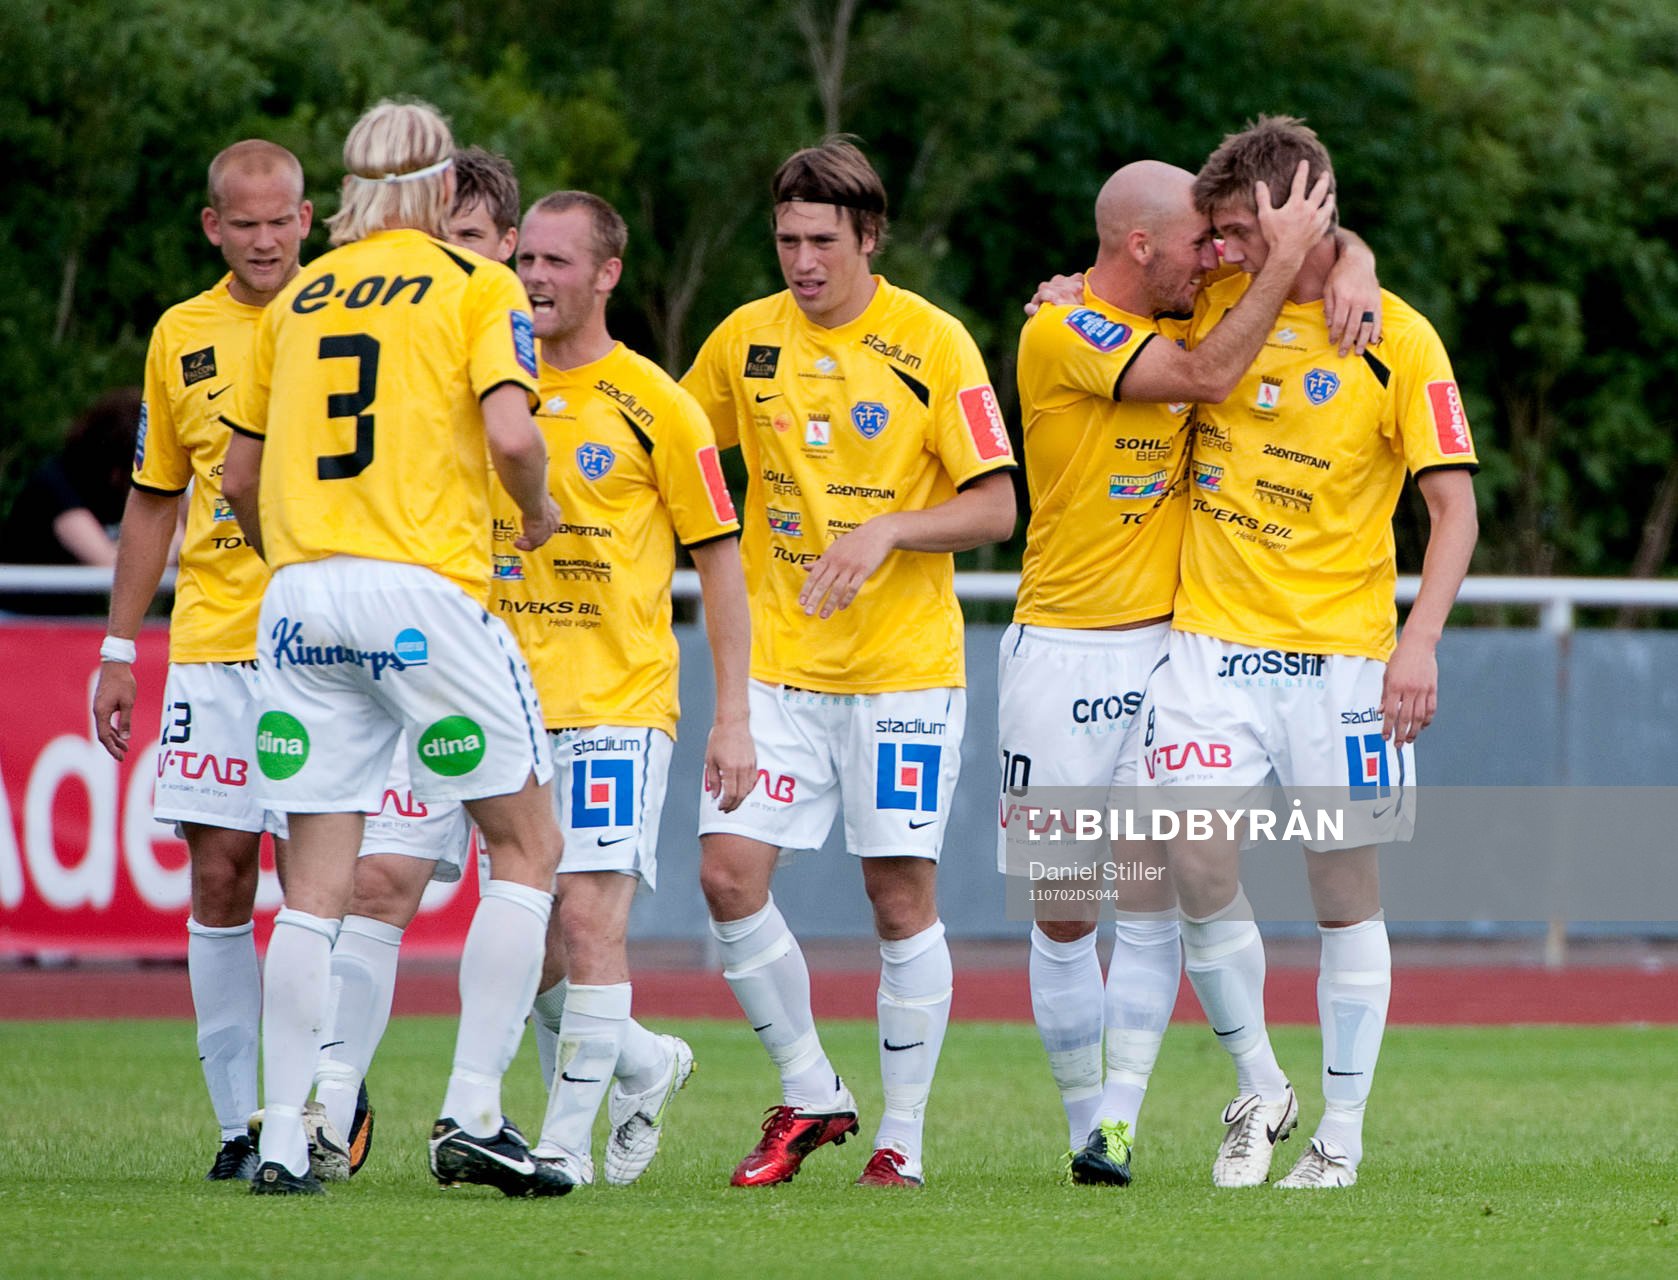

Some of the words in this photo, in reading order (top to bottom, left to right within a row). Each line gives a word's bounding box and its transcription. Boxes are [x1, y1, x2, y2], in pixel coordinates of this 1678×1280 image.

[861, 333, 922, 370] stadium
[317, 333, 380, 480] 3
[593, 379, 655, 428] stadium
[981, 390, 1009, 451] Adecco
[1136, 450, 1173, 462] BER
[1193, 499, 1260, 530] TOEKS
[1261, 522, 1293, 540] BIL
[578, 602, 603, 616] BIL
[257, 731, 304, 756] dina
[875, 717, 946, 735] stadium
[1144, 704, 1156, 748] 8
[423, 734, 481, 758] dina
[572, 735, 641, 756] stadium
[1002, 749, 1032, 798] 10
